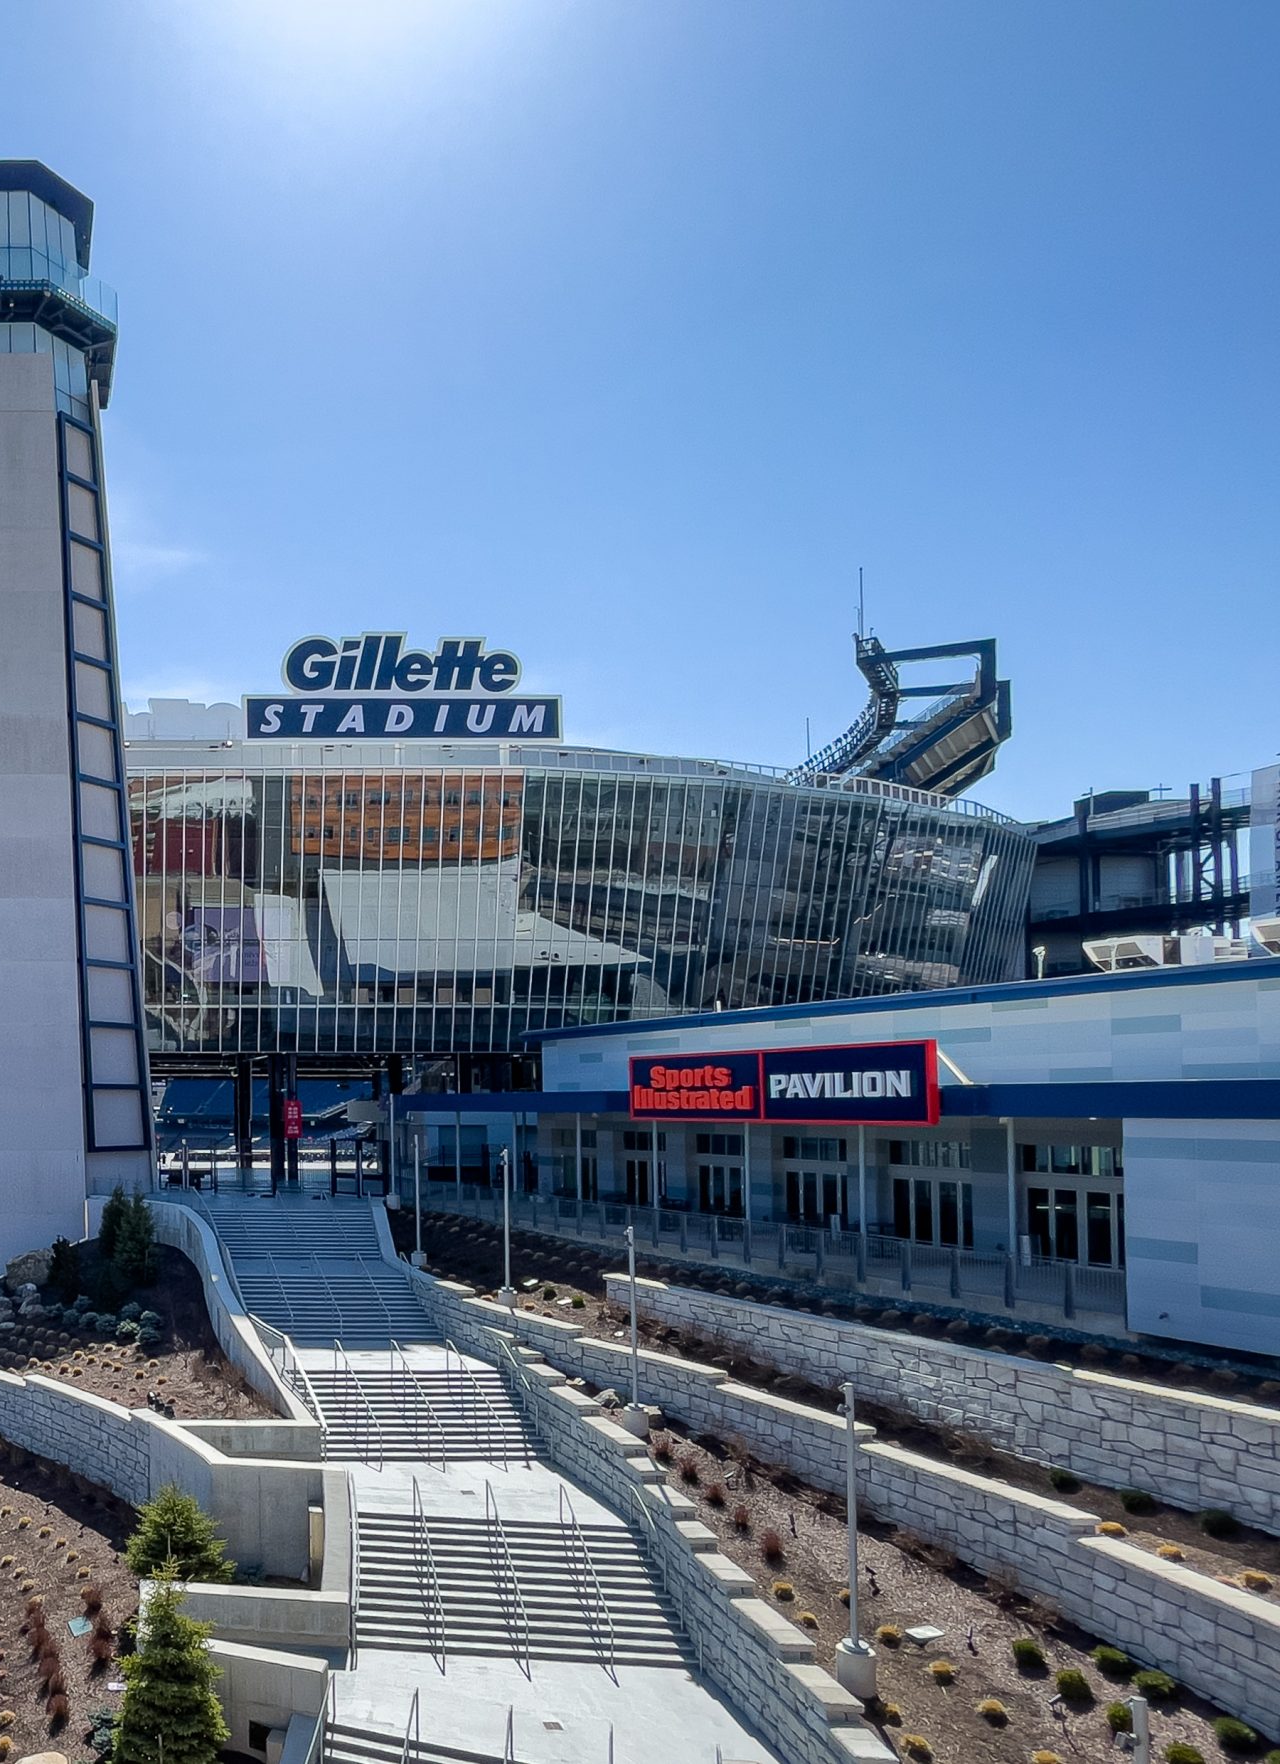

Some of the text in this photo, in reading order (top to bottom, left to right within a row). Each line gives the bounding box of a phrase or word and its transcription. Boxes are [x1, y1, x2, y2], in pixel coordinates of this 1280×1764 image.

[286, 635, 518, 693] Gillette
[260, 704, 546, 733] STADIUM
[650, 1064, 732, 1090] Sports
[769, 1070, 912, 1099] PAVILION
[634, 1085, 754, 1110] Illustrated
